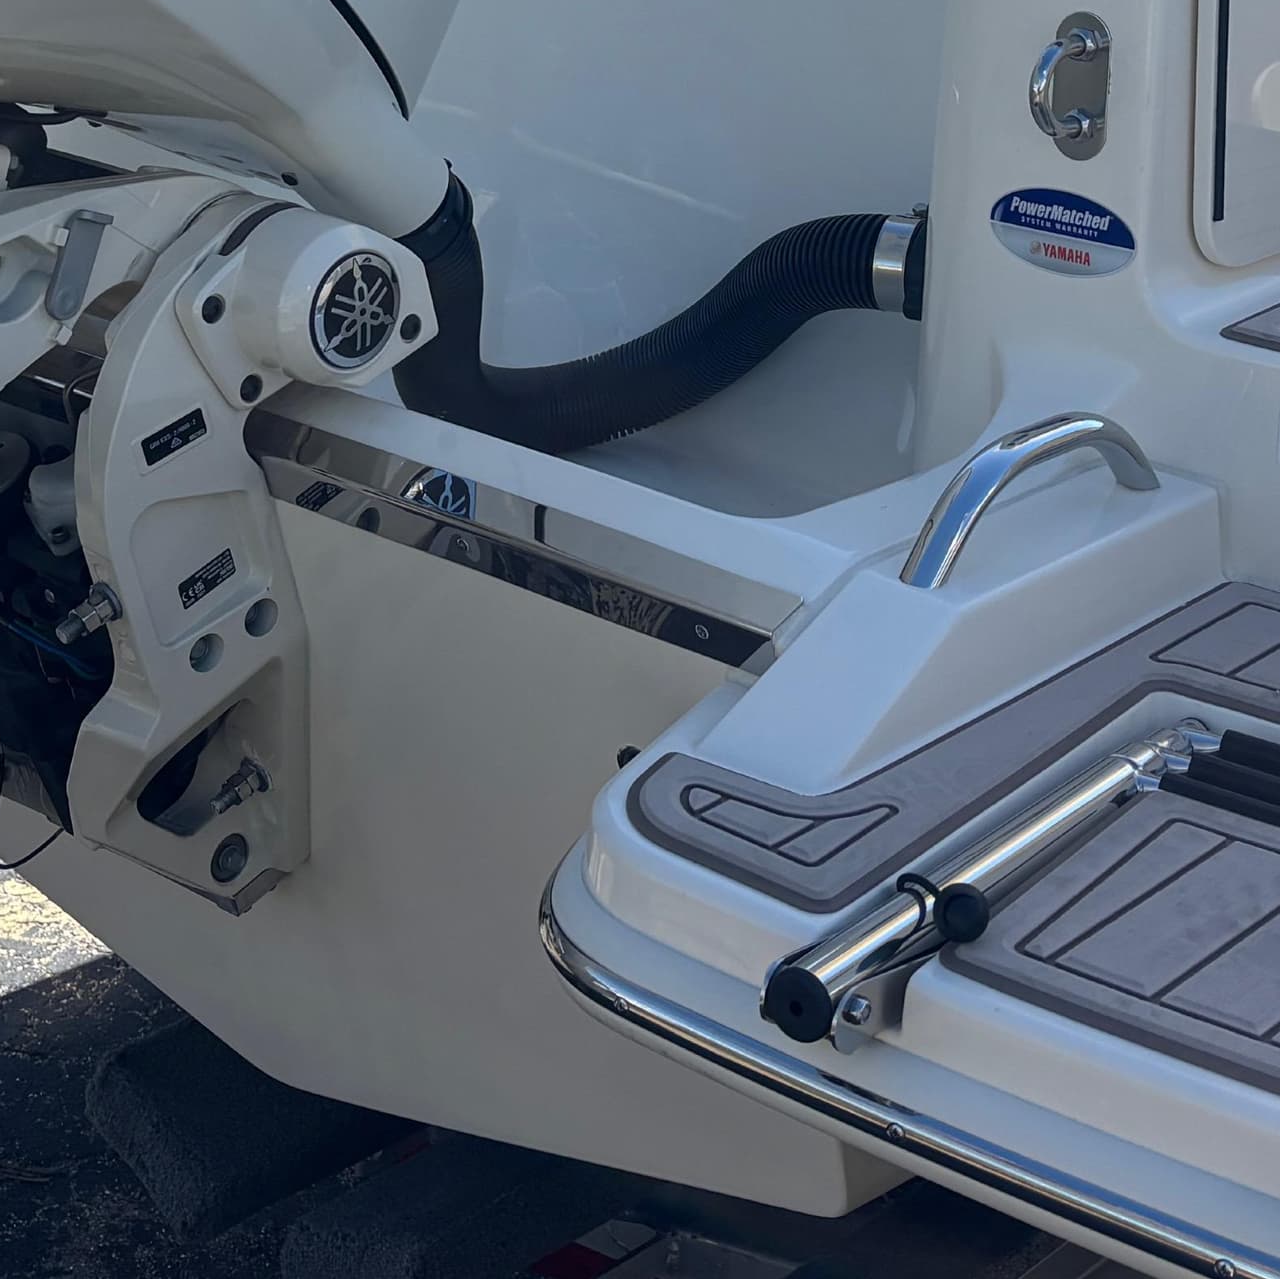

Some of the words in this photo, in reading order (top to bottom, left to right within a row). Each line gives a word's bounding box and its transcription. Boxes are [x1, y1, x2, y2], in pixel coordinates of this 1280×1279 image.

[1010, 196, 1111, 231] PowerMatched
[1020, 215, 1052, 228] SYSTEM
[1055, 222, 1099, 237] WARRANTY
[1042, 243, 1091, 267] YAMAHA
